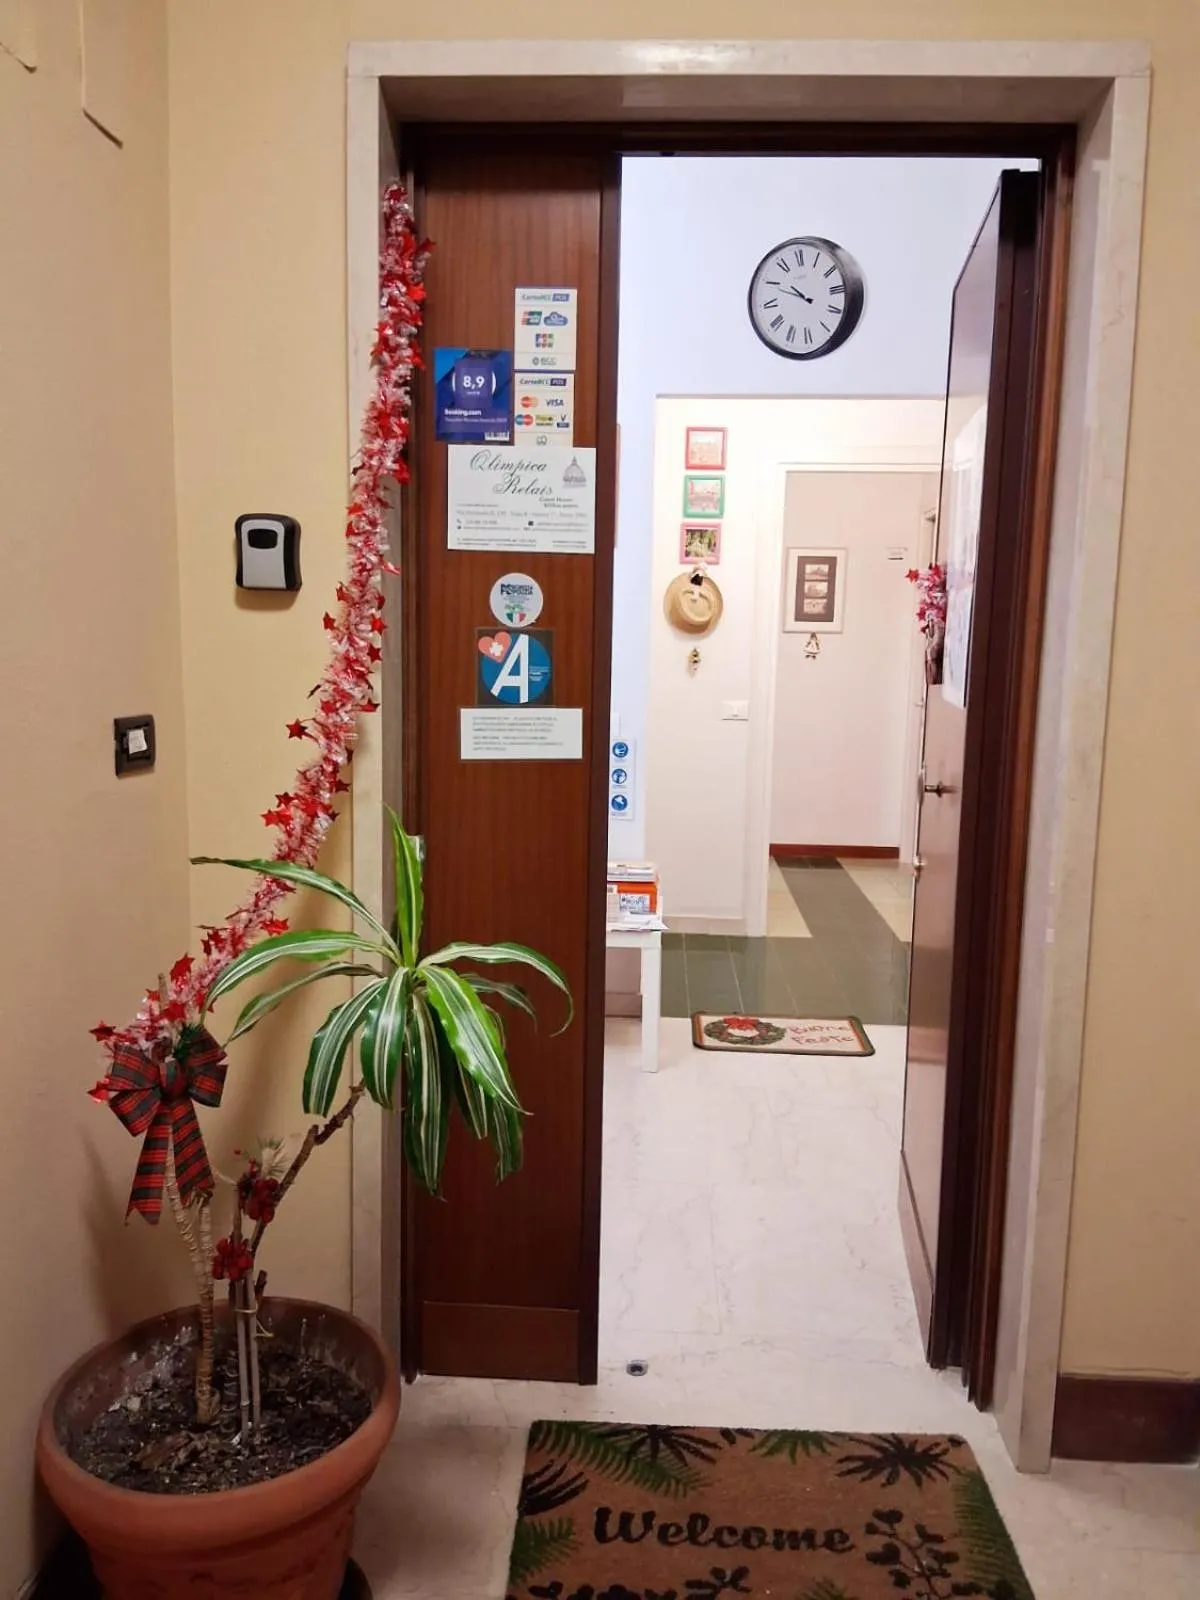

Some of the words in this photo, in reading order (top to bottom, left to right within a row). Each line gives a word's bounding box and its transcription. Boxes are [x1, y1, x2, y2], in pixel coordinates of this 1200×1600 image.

[462, 375, 485, 389] 8,9
[469, 448, 548, 476] Olimpica
[493, 472, 553, 495] Relais
[490, 632, 529, 704] A
[593, 1506, 860, 1554] Welcome
